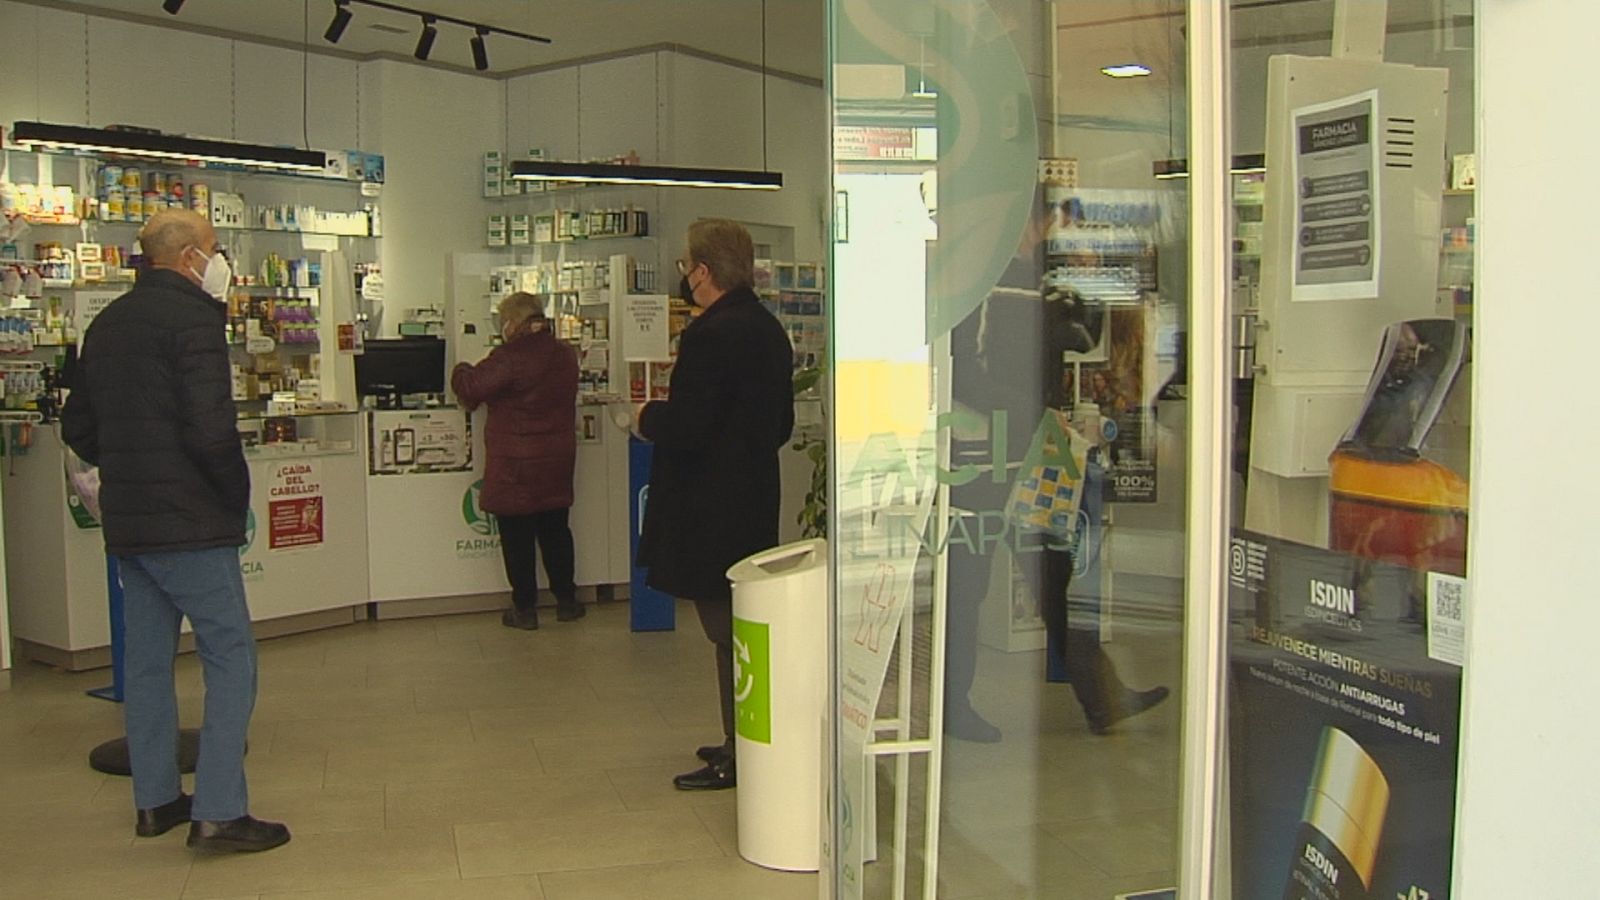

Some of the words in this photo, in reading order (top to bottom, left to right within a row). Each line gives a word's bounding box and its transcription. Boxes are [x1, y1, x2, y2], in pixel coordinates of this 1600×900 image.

[1312, 121, 1357, 139] FARMACIA
[271, 484, 320, 495] CABELLO?
[286, 476, 305, 484] DEL
[1113, 476, 1154, 486] 100%
[851, 509, 1082, 559] LINARES
[1310, 580, 1355, 615] ISDIN
[1252, 625, 1319, 661] REJUVENECE
[1318, 648, 1378, 681] MIENTRAS
[1378, 667, 1433, 698] SUEÑAS
[1273, 658, 1309, 682] POTENTE
[1339, 683, 1406, 716] ANTIARRUGAS
[1377, 714, 1396, 730] todo
[1395, 718, 1413, 737] tipo
[1412, 725, 1424, 738] de
[1423, 729, 1440, 745] piel
[1304, 844, 1339, 884] ISDIN
